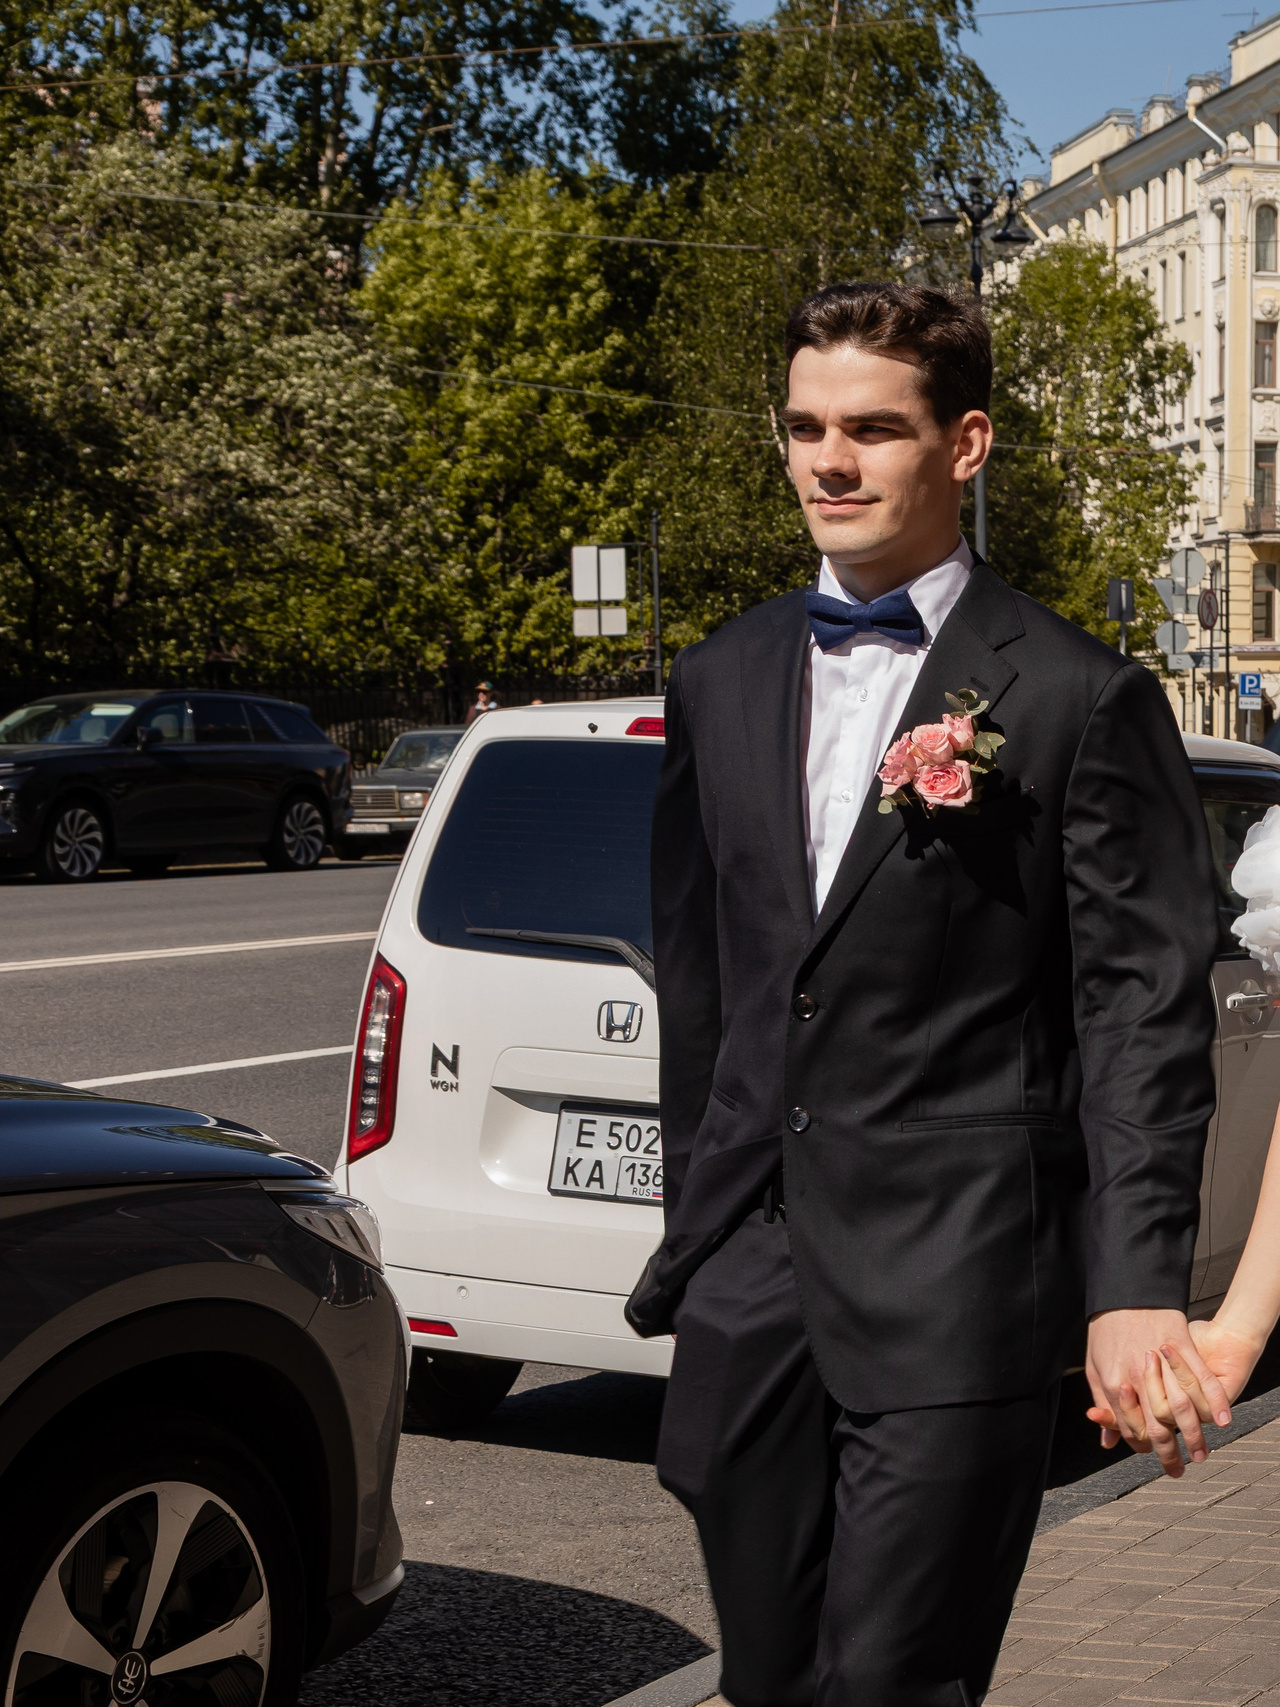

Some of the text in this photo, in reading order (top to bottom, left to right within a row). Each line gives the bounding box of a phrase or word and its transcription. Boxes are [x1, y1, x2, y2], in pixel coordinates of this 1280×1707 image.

[1245, 675, 1258, 694] P
[430, 1042, 460, 1080] N
[430, 1079, 459, 1093] WGN
[606, 1121, 661, 1155] 502
[625, 1162, 664, 1188] 136
[632, 1187, 651, 1197] RUS
